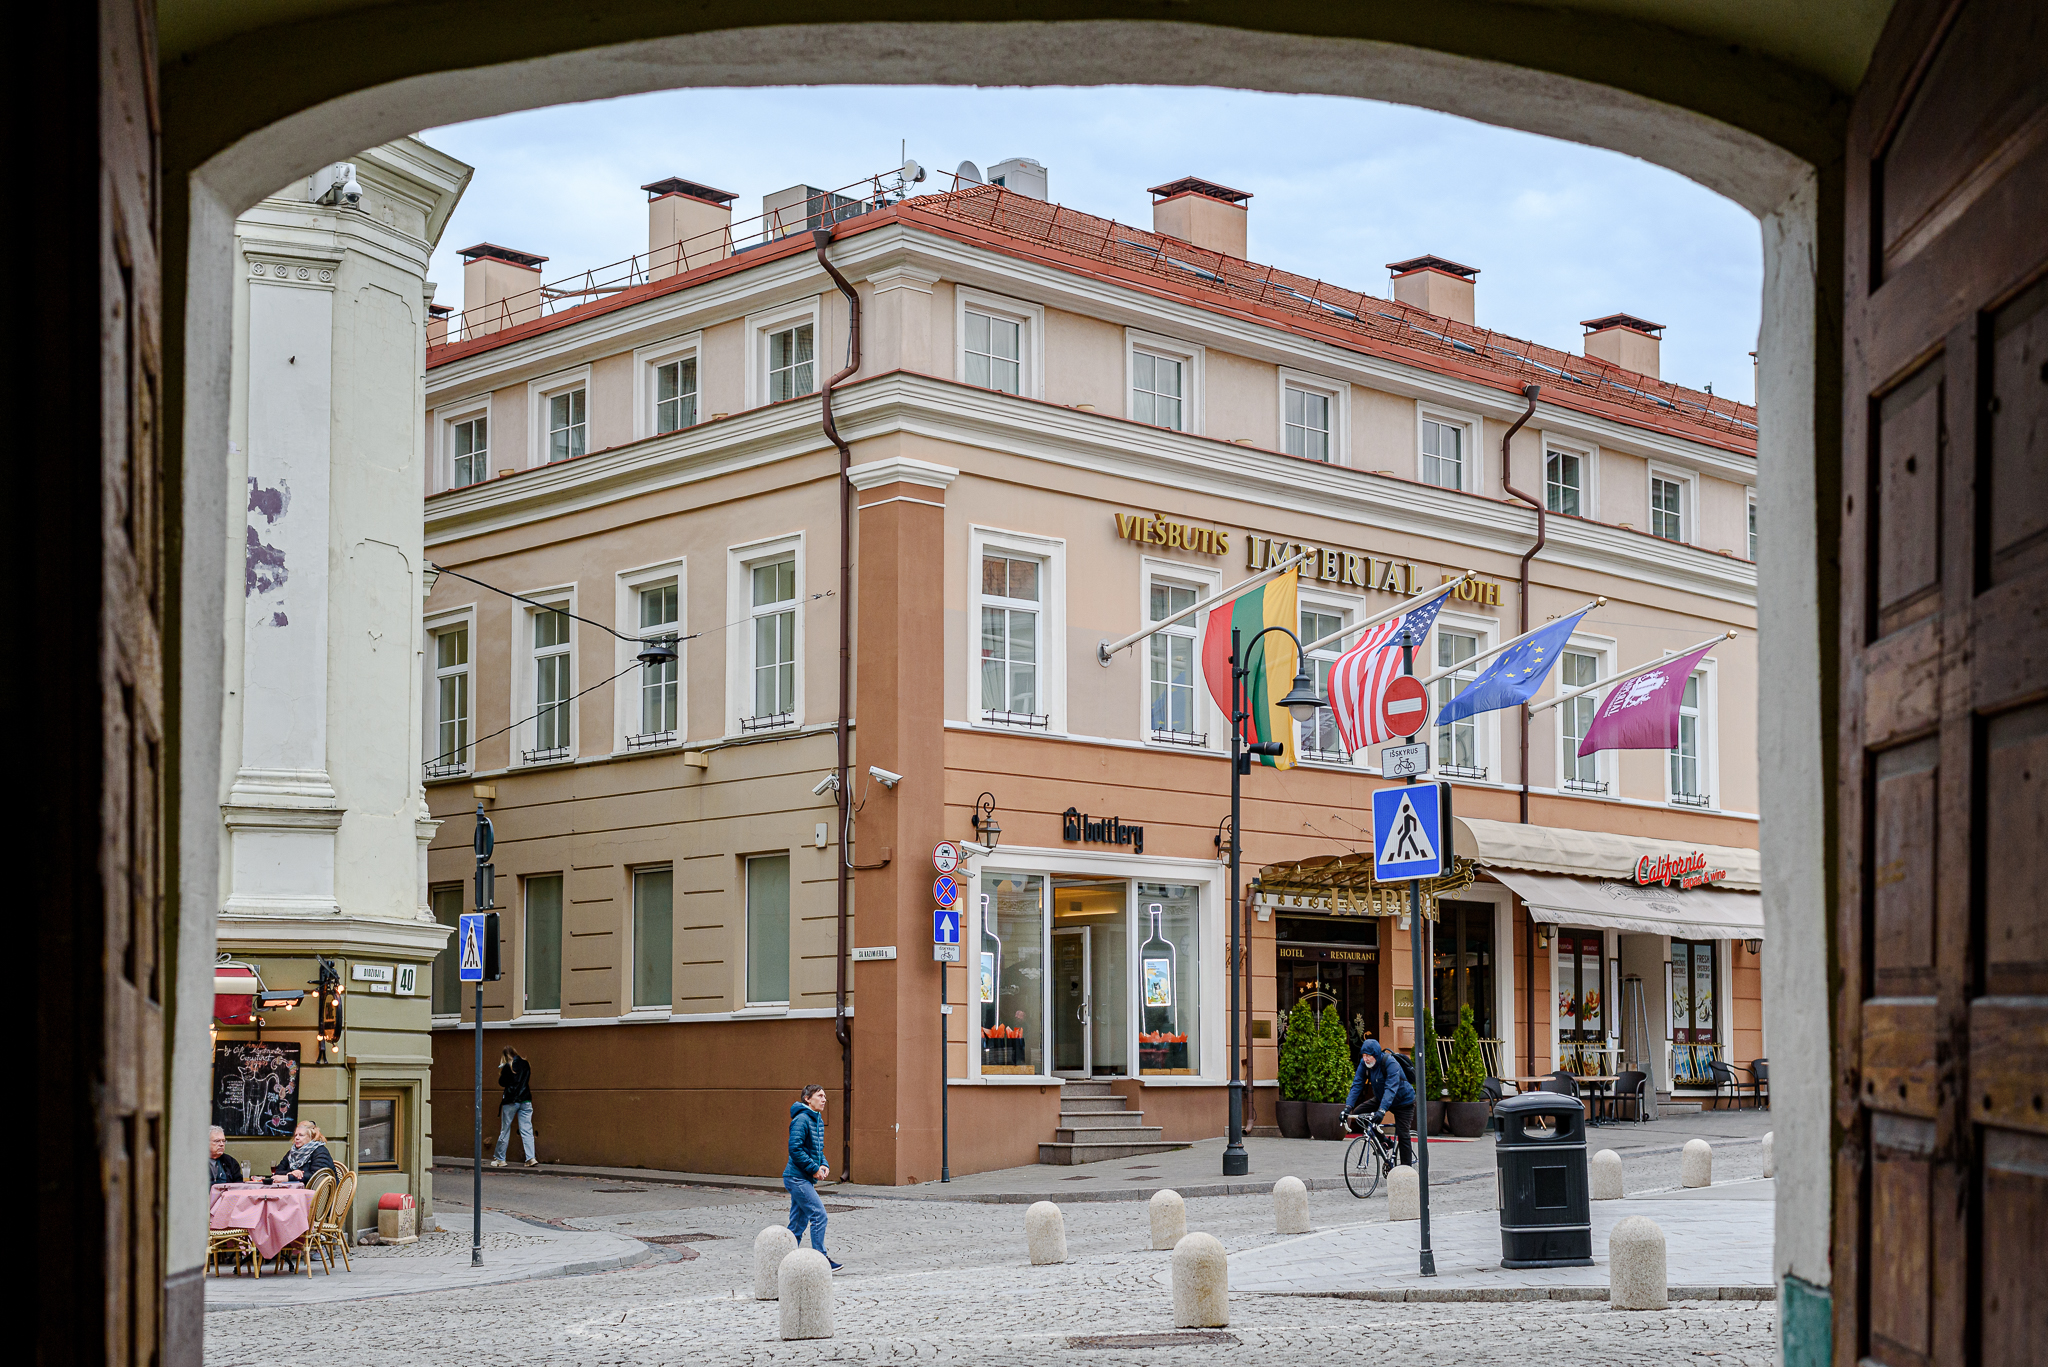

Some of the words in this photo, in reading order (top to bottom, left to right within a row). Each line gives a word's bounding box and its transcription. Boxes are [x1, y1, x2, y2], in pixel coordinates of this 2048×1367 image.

[1115, 513, 1230, 555] VIEŠBUTIS
[1246, 534, 1425, 596] IMPERIAL
[1389, 747, 1418, 758] IŠSKYRUS
[1083, 813, 1143, 854] bottlery
[1635, 851, 1706, 887] California
[1680, 874, 1702, 890] tapas
[1703, 871, 1710, 884] &
[1710, 868, 1726, 881] wine
[1280, 948, 1304, 958] HOTEL
[1330, 951, 1376, 960] RESTAURANT
[400, 968, 414, 991] 40
